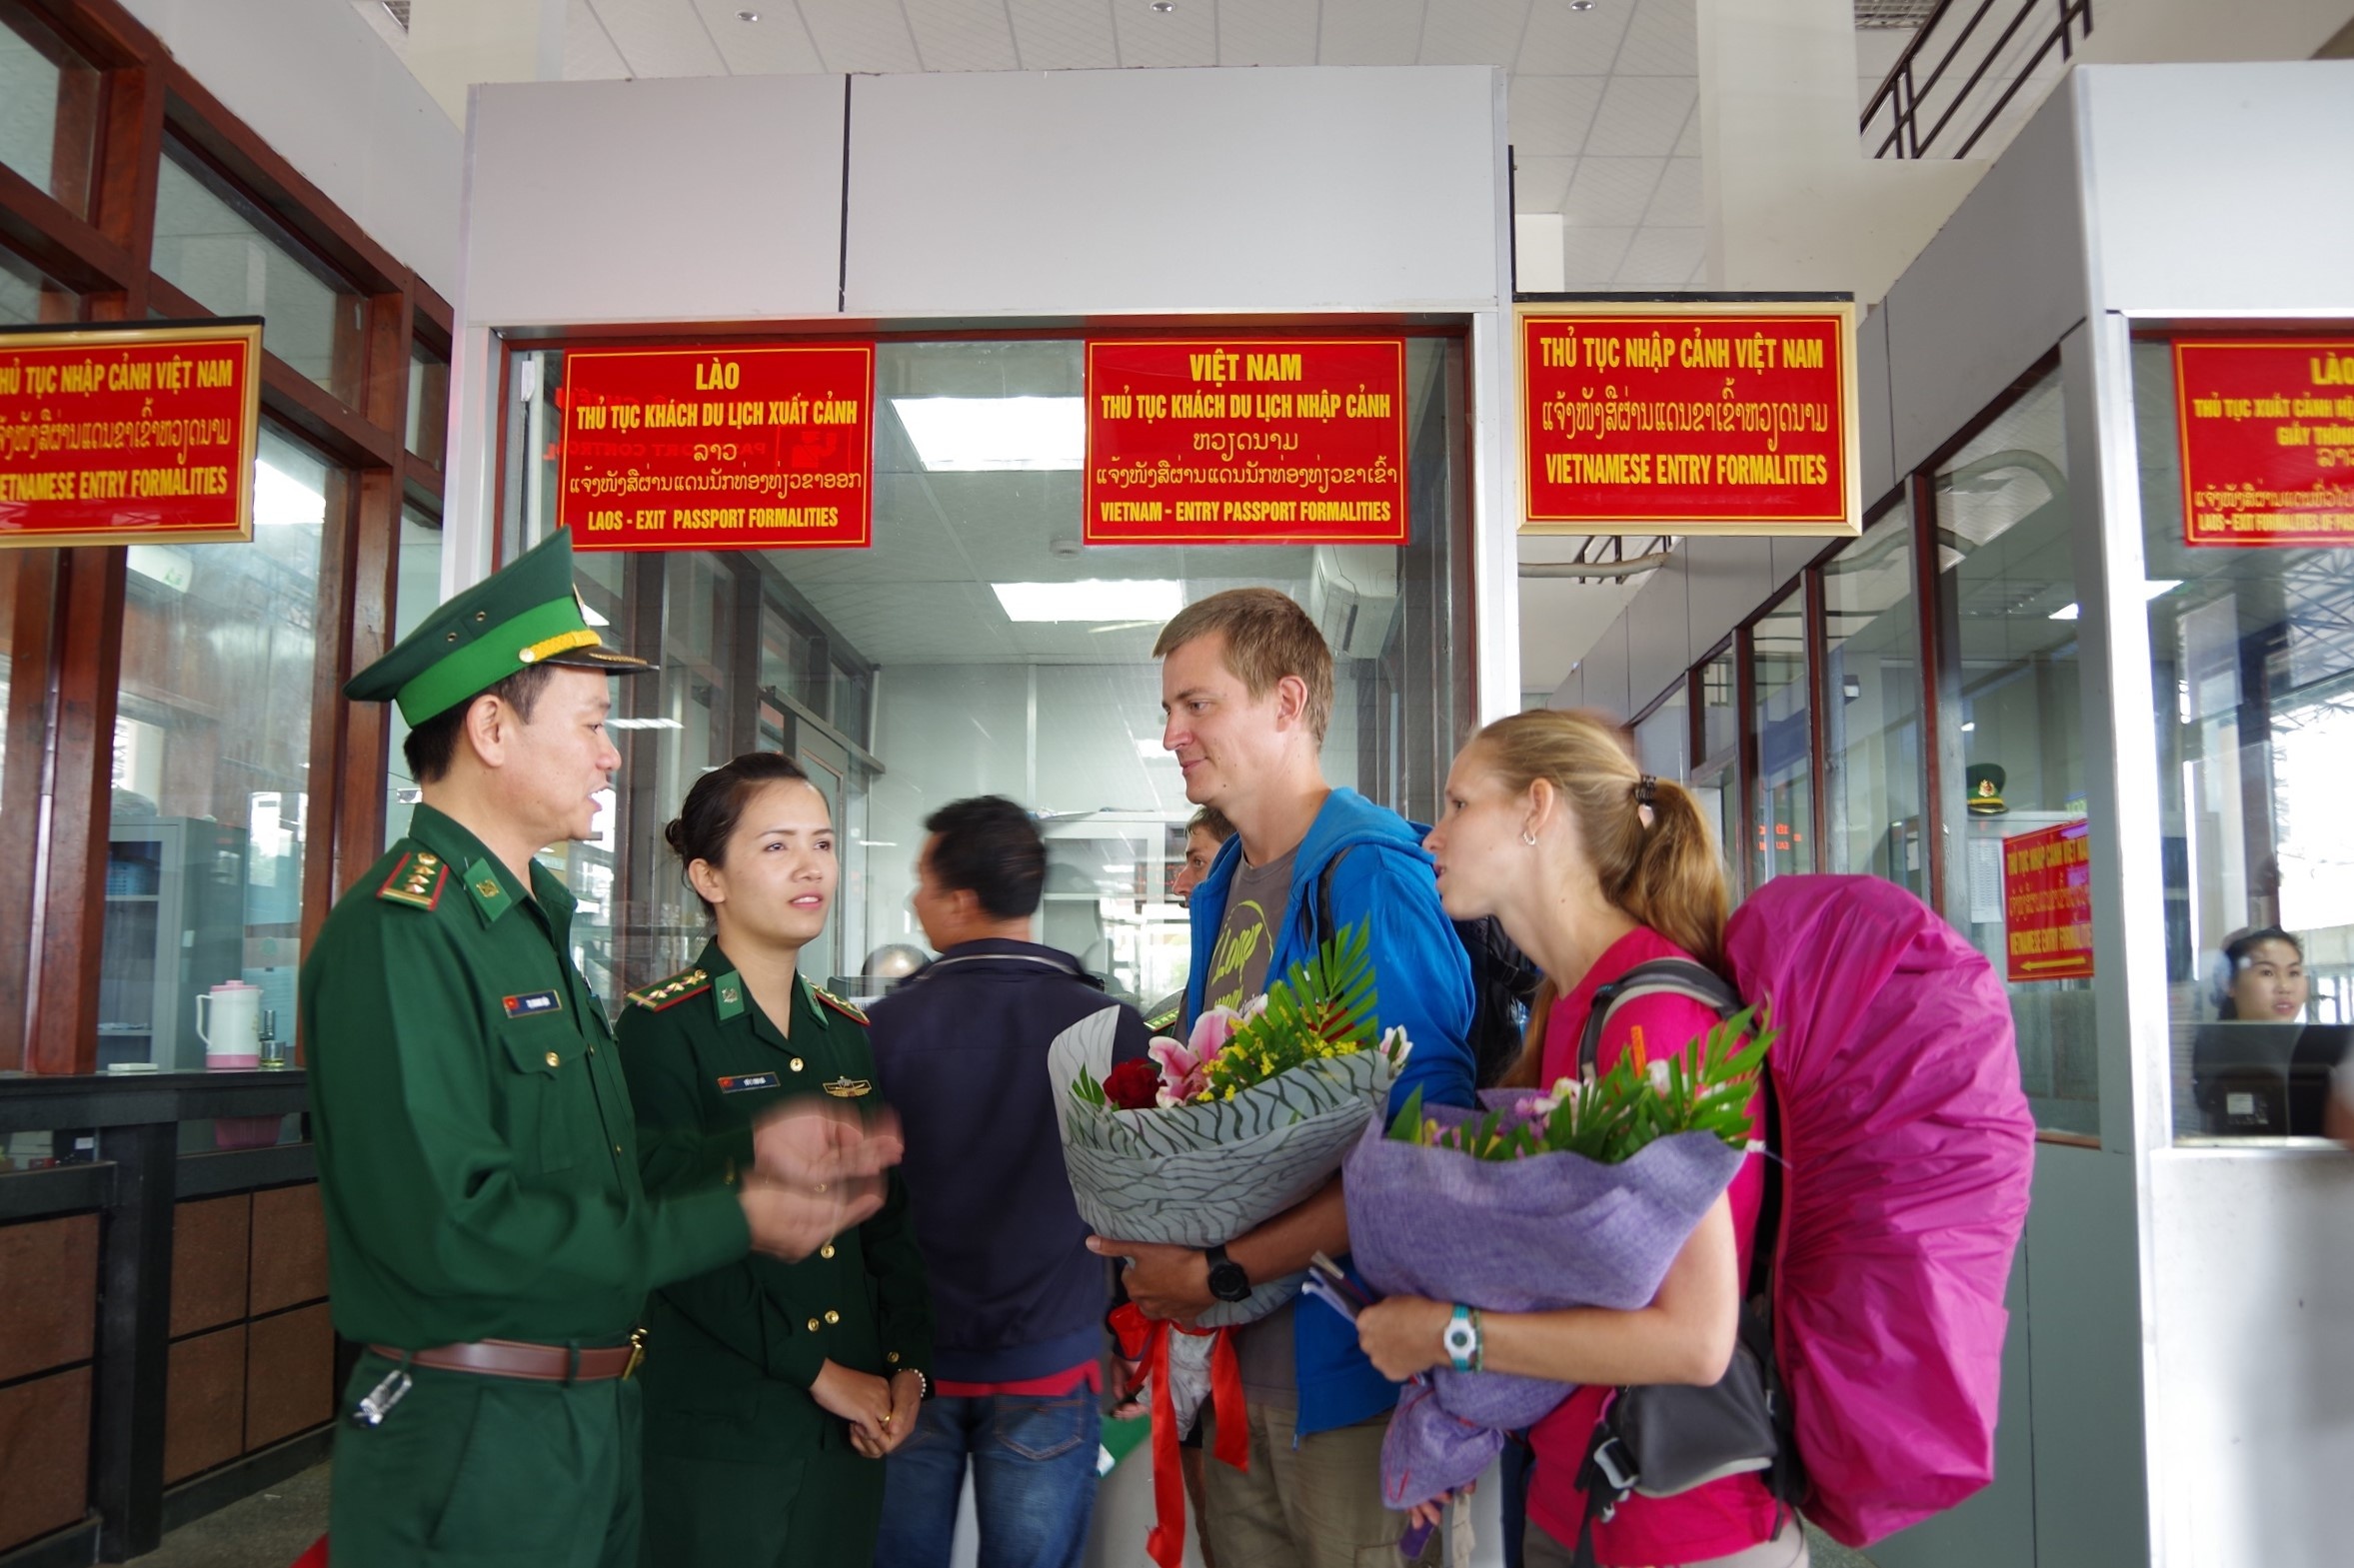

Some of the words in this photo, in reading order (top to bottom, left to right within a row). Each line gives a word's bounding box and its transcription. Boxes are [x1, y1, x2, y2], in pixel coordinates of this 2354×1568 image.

[1540, 326, 1576, 367] THỦ
[1583, 338, 1619, 373] TỤC
[1625, 331, 1675, 373] NHẬP
[1680, 328, 1729, 368] CẢNH
[1735, 332, 1776, 375] VIỆT
[1783, 339, 1822, 368] NAM
[26, 367, 56, 398] TỤC
[61, 360, 104, 396] NHẬP
[109, 354, 151, 391] CẢNH
[157, 356, 192, 393] VIỆT
[198, 360, 232, 387] NAM
[696, 358, 739, 390] LÀO
[1189, 349, 1239, 387] VIỆT
[1247, 354, 1301, 381] NAM
[577, 397, 606, 429] THỦ
[611, 405, 640, 433] TỤC
[645, 400, 698, 428] KHÁCH
[703, 403, 724, 426] DU
[729, 402, 764, 429] LỊCH
[769, 393, 809, 425] XUẤT
[814, 391, 857, 424] CẢNH
[1102, 386, 1132, 419] THỦ
[1137, 395, 1167, 424] TỤC
[1172, 390, 1224, 418] KHÁCH
[1230, 395, 1251, 418] DU
[1256, 395, 1291, 422] LỊCH
[1297, 390, 1340, 423] NHẬP
[1346, 384, 1389, 418] CẢNH
[2193, 393, 2222, 418] THỦ
[2223, 399, 2252, 421] TỤC
[80, 471, 127, 499] ENTRY
[132, 467, 227, 497] FORMALITIES
[1546, 454, 1651, 484] VIETNAMESE
[1657, 455, 1711, 484] ENTRY
[1716, 455, 1827, 485] FORMALITIES
[589, 511, 623, 530] LAOS
[637, 510, 666, 529] EXIT
[674, 509, 745, 529] PASSPORT
[749, 507, 838, 528] FORMALITIES
[1101, 502, 1162, 522] VIETNAM
[1177, 502, 1219, 521] ENTRY
[1223, 502, 1296, 522] PASSPORT
[1300, 502, 1390, 521] FORMALITIES
[2198, 513, 2226, 533] LAOS
